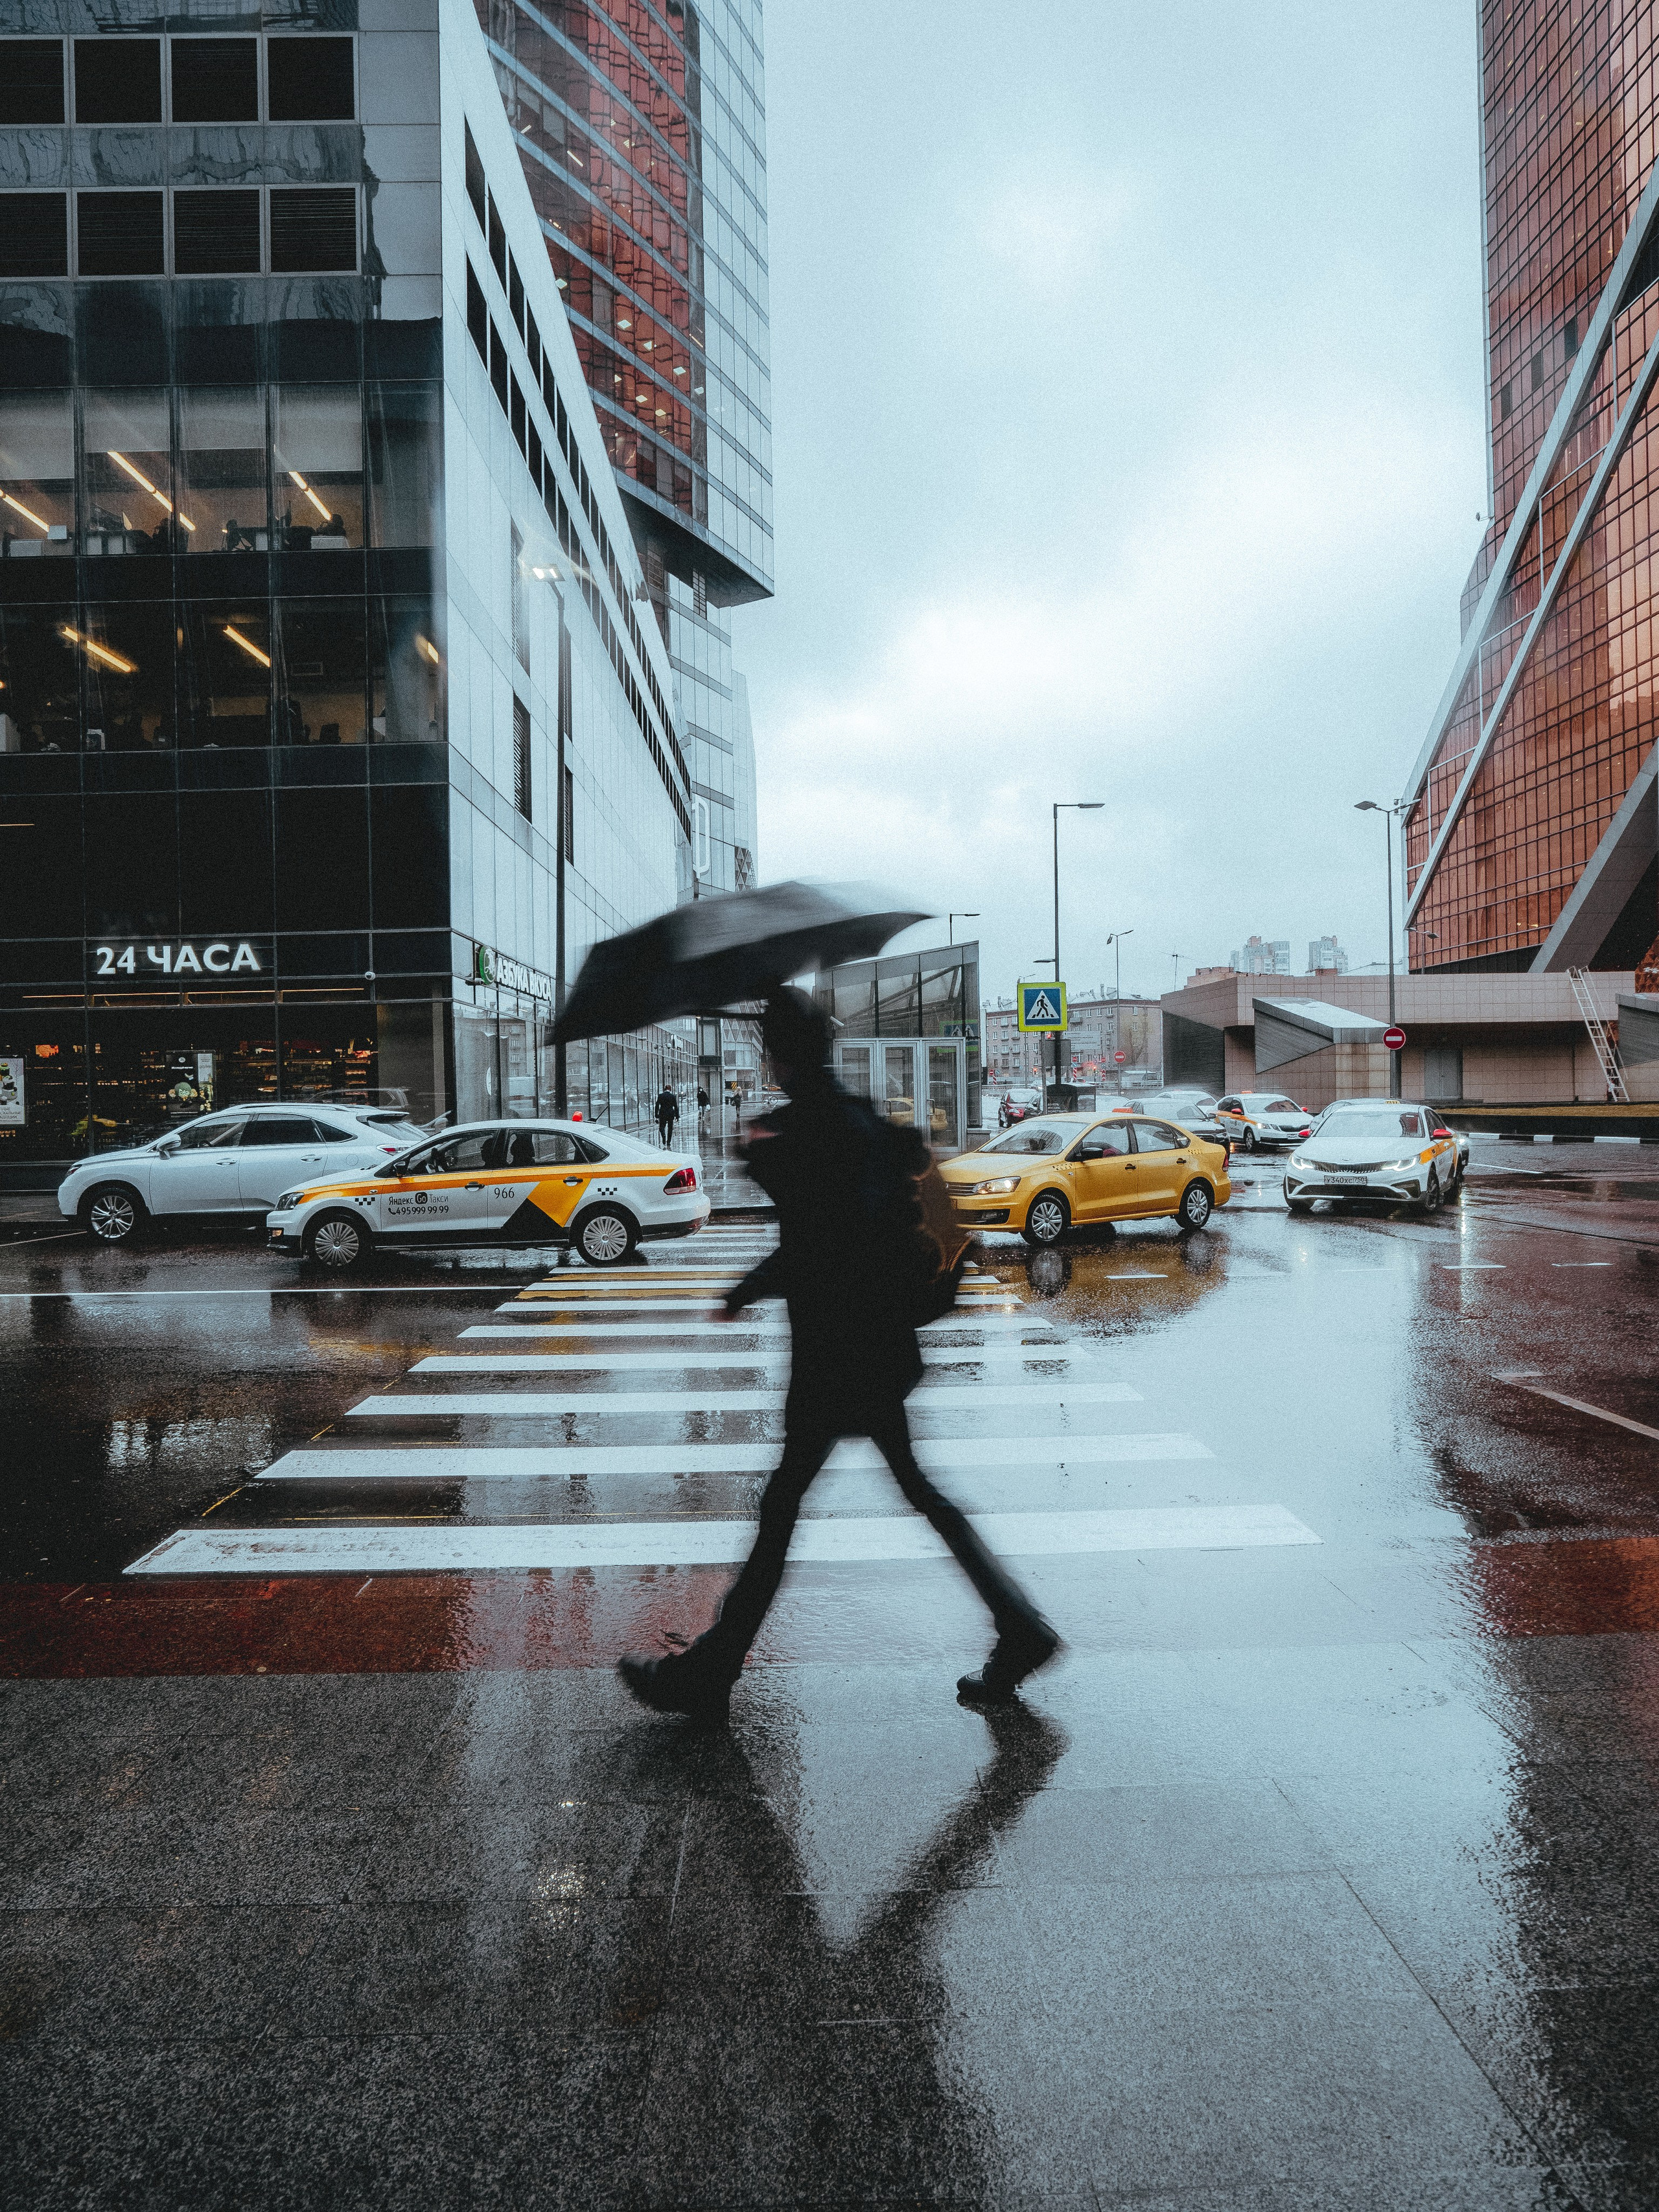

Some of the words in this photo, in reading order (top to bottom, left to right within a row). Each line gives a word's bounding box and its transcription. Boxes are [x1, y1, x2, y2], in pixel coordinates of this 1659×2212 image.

[97, 946, 135, 974] 24
[147, 944, 261, 973] ЧАСА
[496, 957, 529, 993] АЗБУКА
[529, 969, 551, 1001] ВКУСА
[389, 1196, 414, 1205] Яндекс
[417, 1193, 427, 1204] Go
[429, 1194, 448, 1204] Такси
[494, 1187, 515, 1199] 966
[428, 1205, 437, 1214] 99
[439, 1205, 449, 1214] 99
